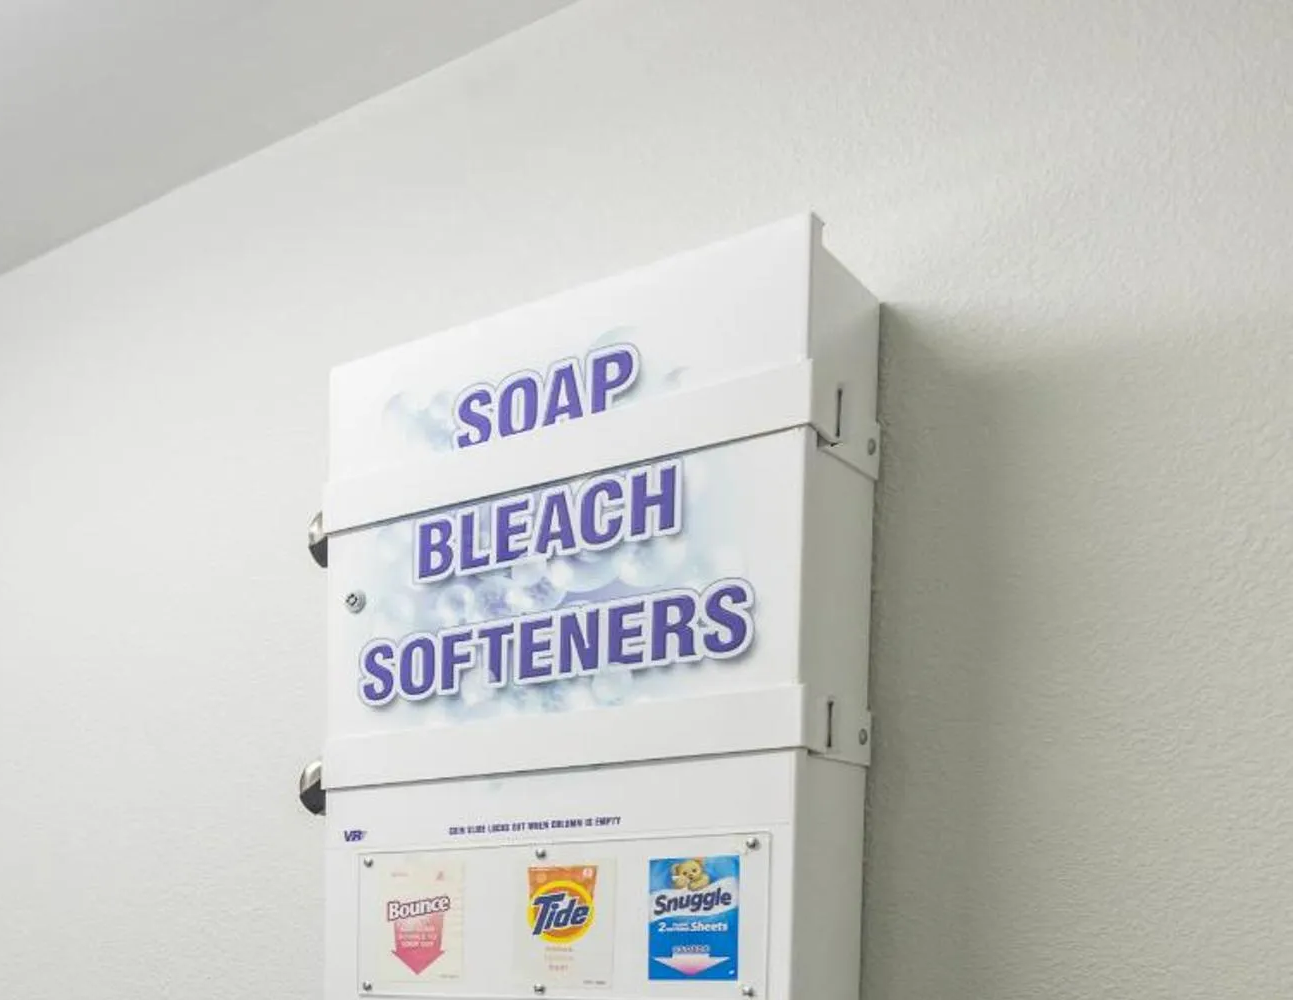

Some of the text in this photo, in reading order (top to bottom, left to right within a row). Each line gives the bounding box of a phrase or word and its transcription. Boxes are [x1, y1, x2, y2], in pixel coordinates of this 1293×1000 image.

[455, 347, 635, 449] SOAP
[416, 464, 679, 582] BLEACH
[360, 583, 750, 702] SOFTENERS
[595, 815, 621, 827] EMPTY
[387, 895, 450, 921] Bounce
[531, 892, 590, 936] Tide
[653, 886, 732, 916] Snuggle
[658, 921, 668, 932] 2
[690, 920, 729, 932] Sheets
